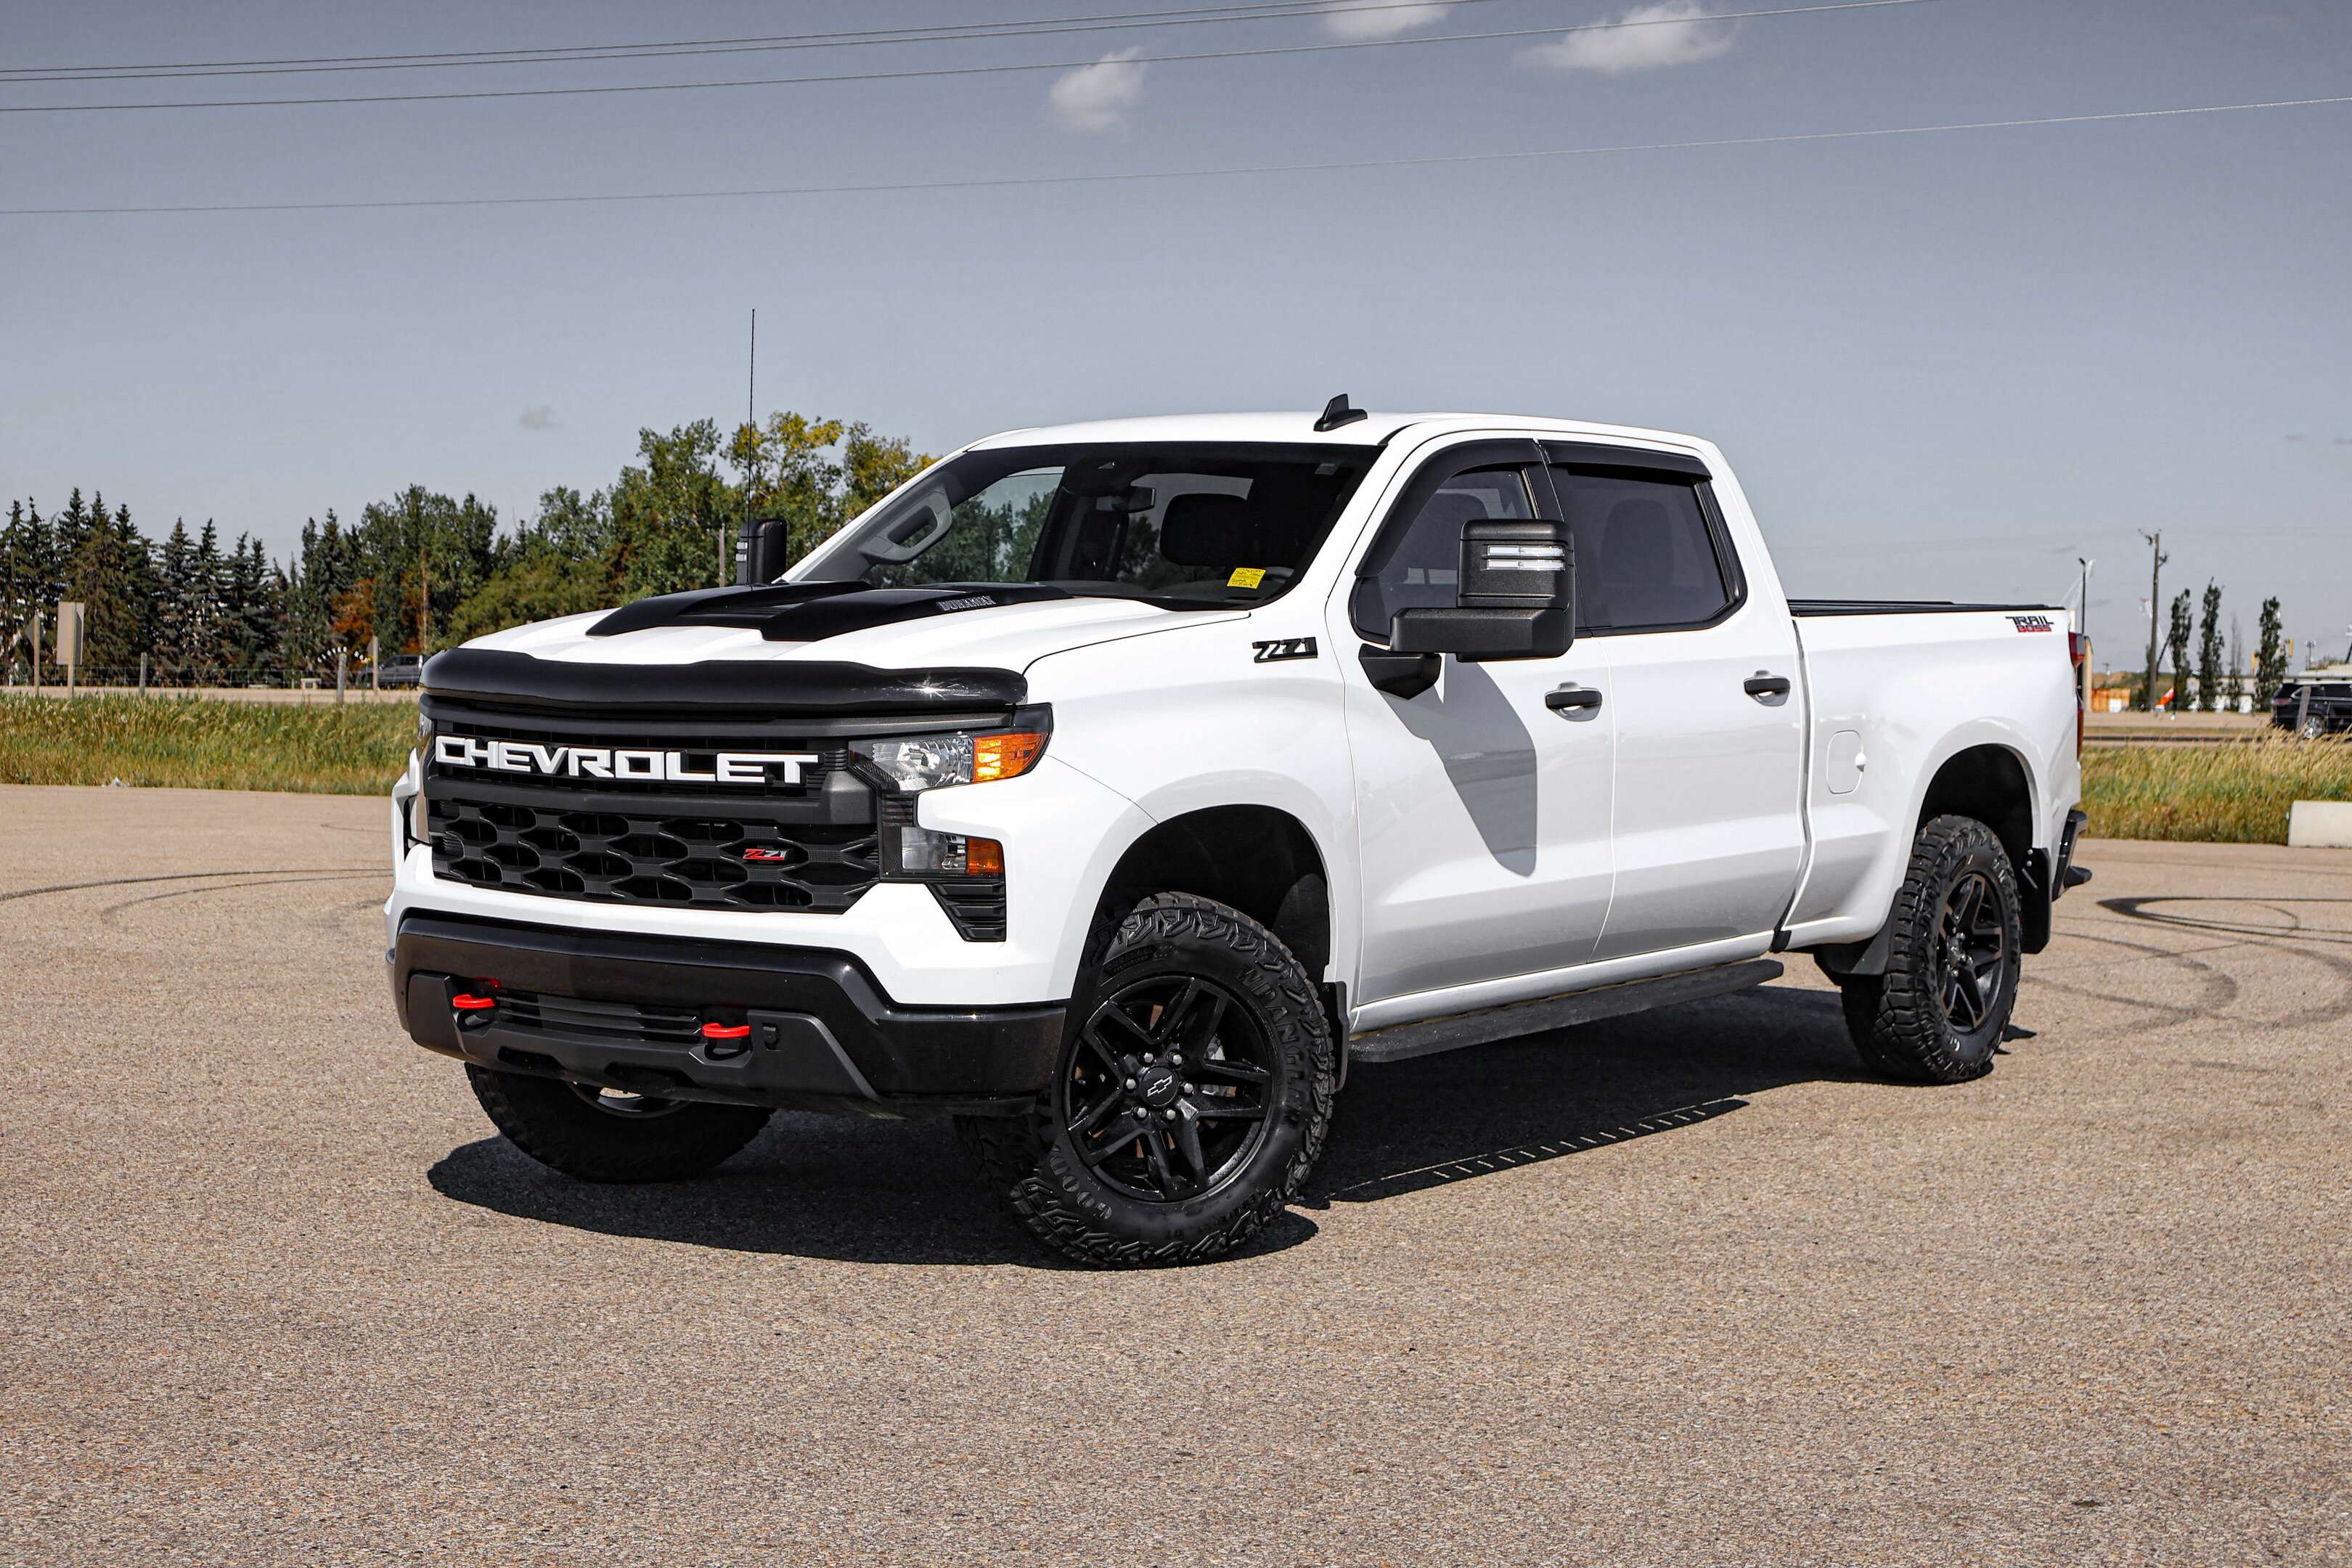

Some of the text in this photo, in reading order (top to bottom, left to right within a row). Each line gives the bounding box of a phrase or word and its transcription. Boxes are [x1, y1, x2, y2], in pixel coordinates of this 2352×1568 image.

[936, 595, 997, 611] DURAMAX
[2005, 616, 2054, 626] TRAIL
[1252, 636, 1318, 663] Z71
[435, 735, 819, 784] CHEVROLET
[742, 848, 789, 861] Z71
